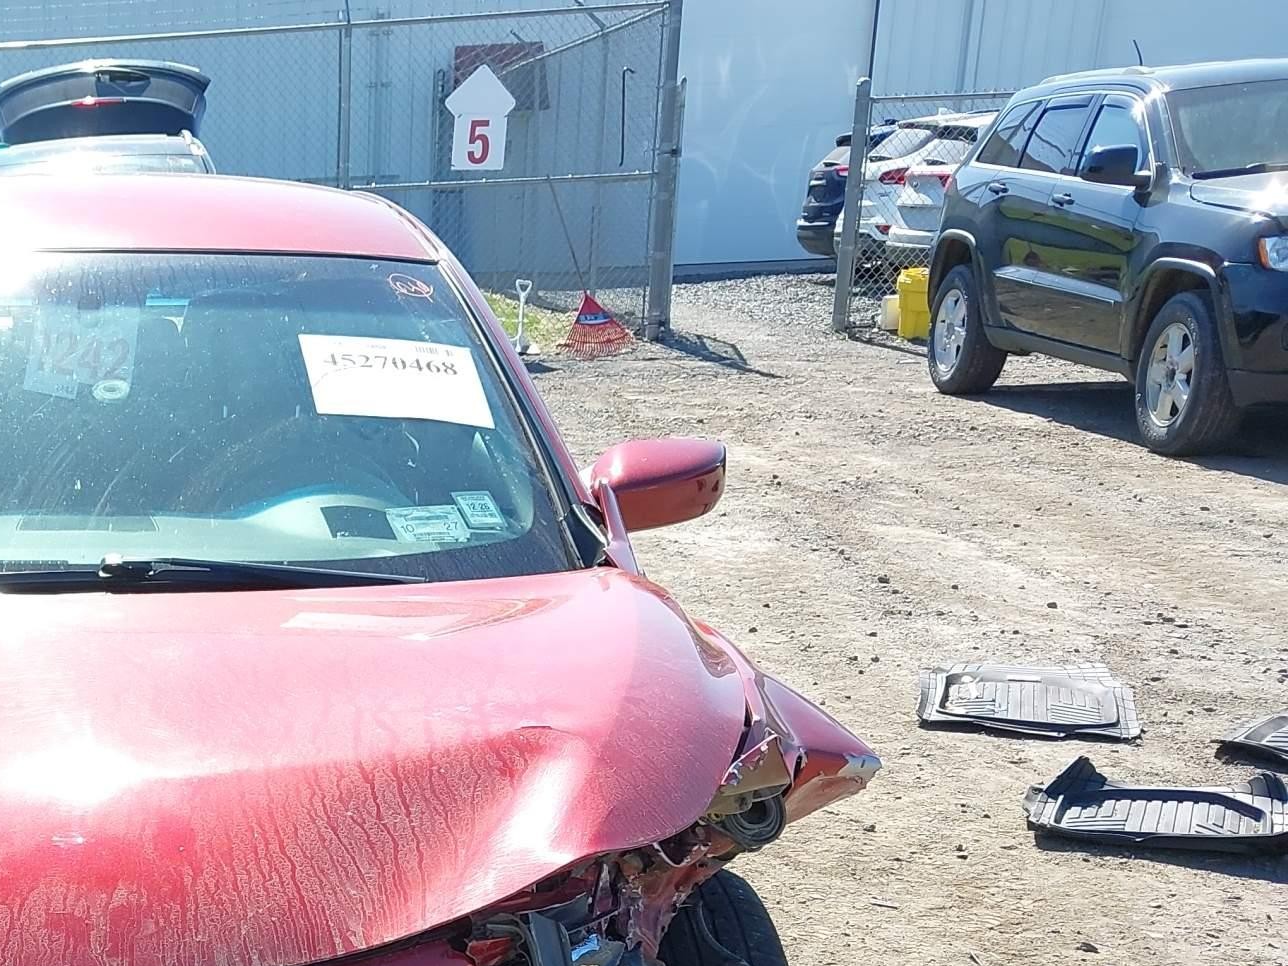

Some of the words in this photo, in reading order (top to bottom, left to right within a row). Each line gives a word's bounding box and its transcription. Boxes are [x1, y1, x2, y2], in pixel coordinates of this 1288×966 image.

[467, 119, 490, 165] 5
[323, 352, 458, 376] 45270468
[400, 523, 415, 534] 10
